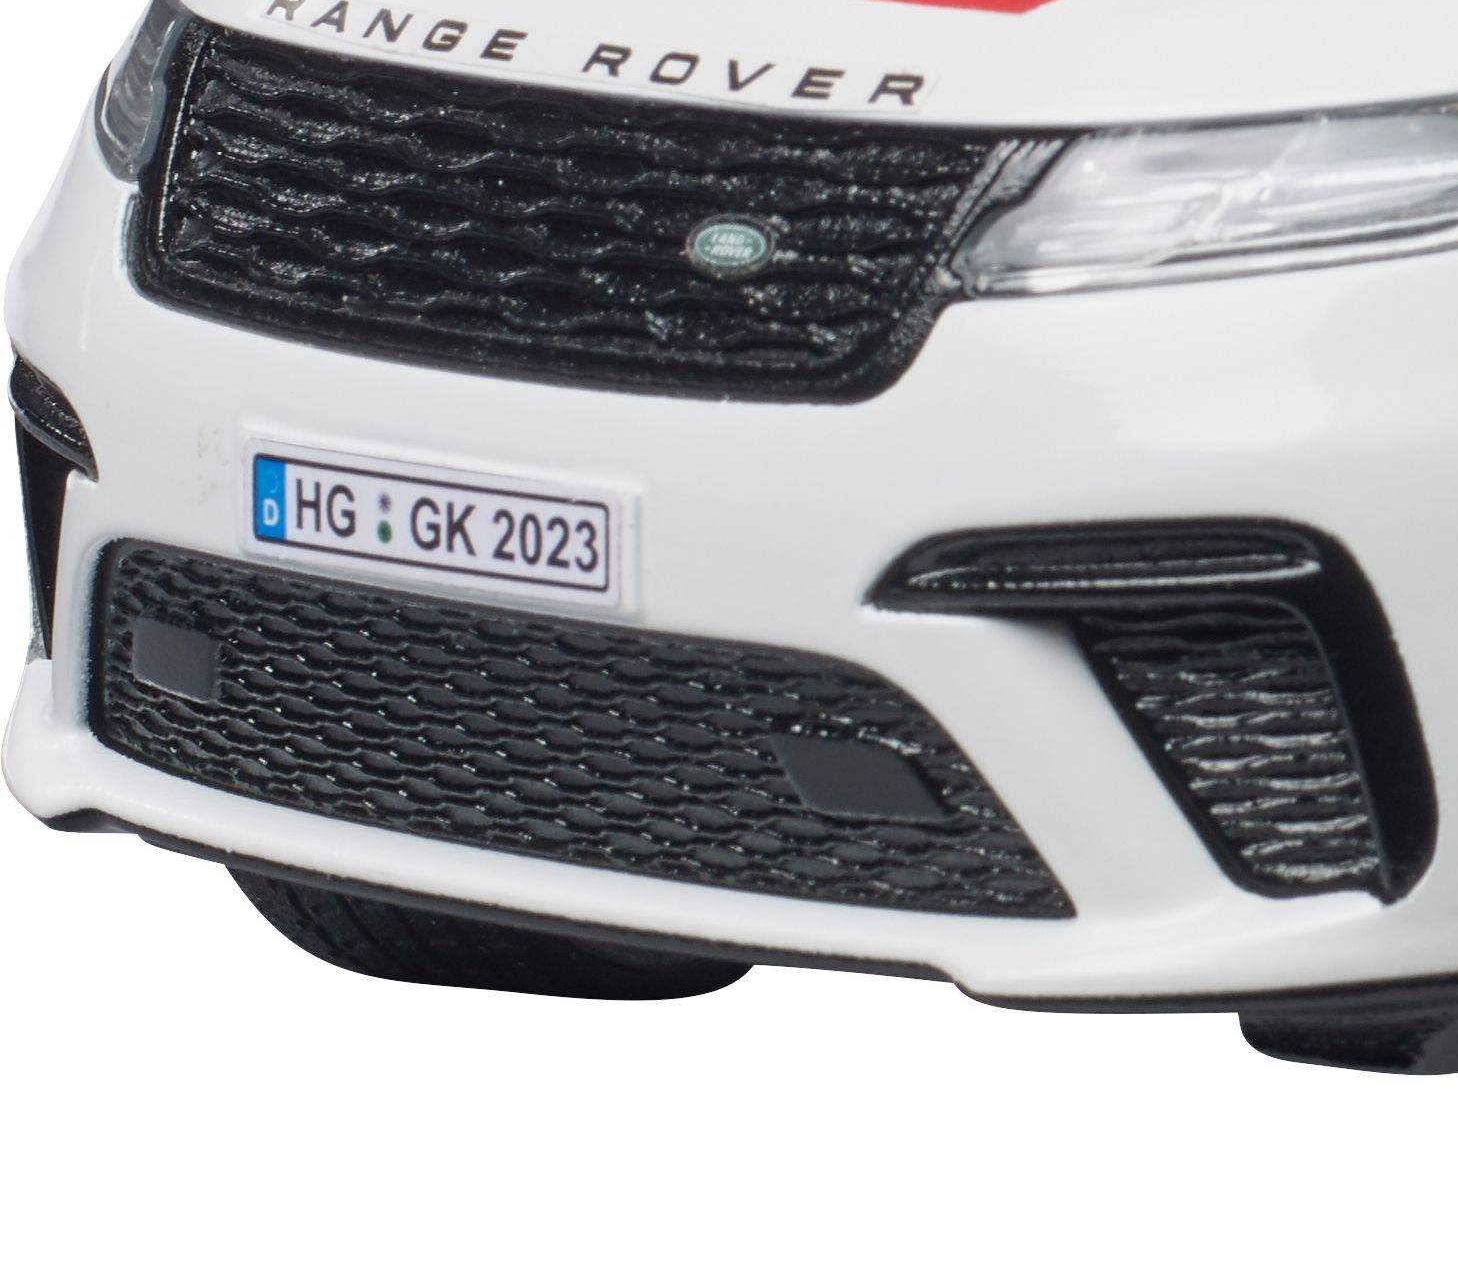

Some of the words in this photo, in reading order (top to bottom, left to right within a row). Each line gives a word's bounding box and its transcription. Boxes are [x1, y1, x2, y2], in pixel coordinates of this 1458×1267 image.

[582, 42, 925, 106] ROVER
[262, 498, 280, 526] D
[294, 477, 358, 539] HG
[409, 495, 478, 557] GK
[492, 508, 600, 573] 2023
